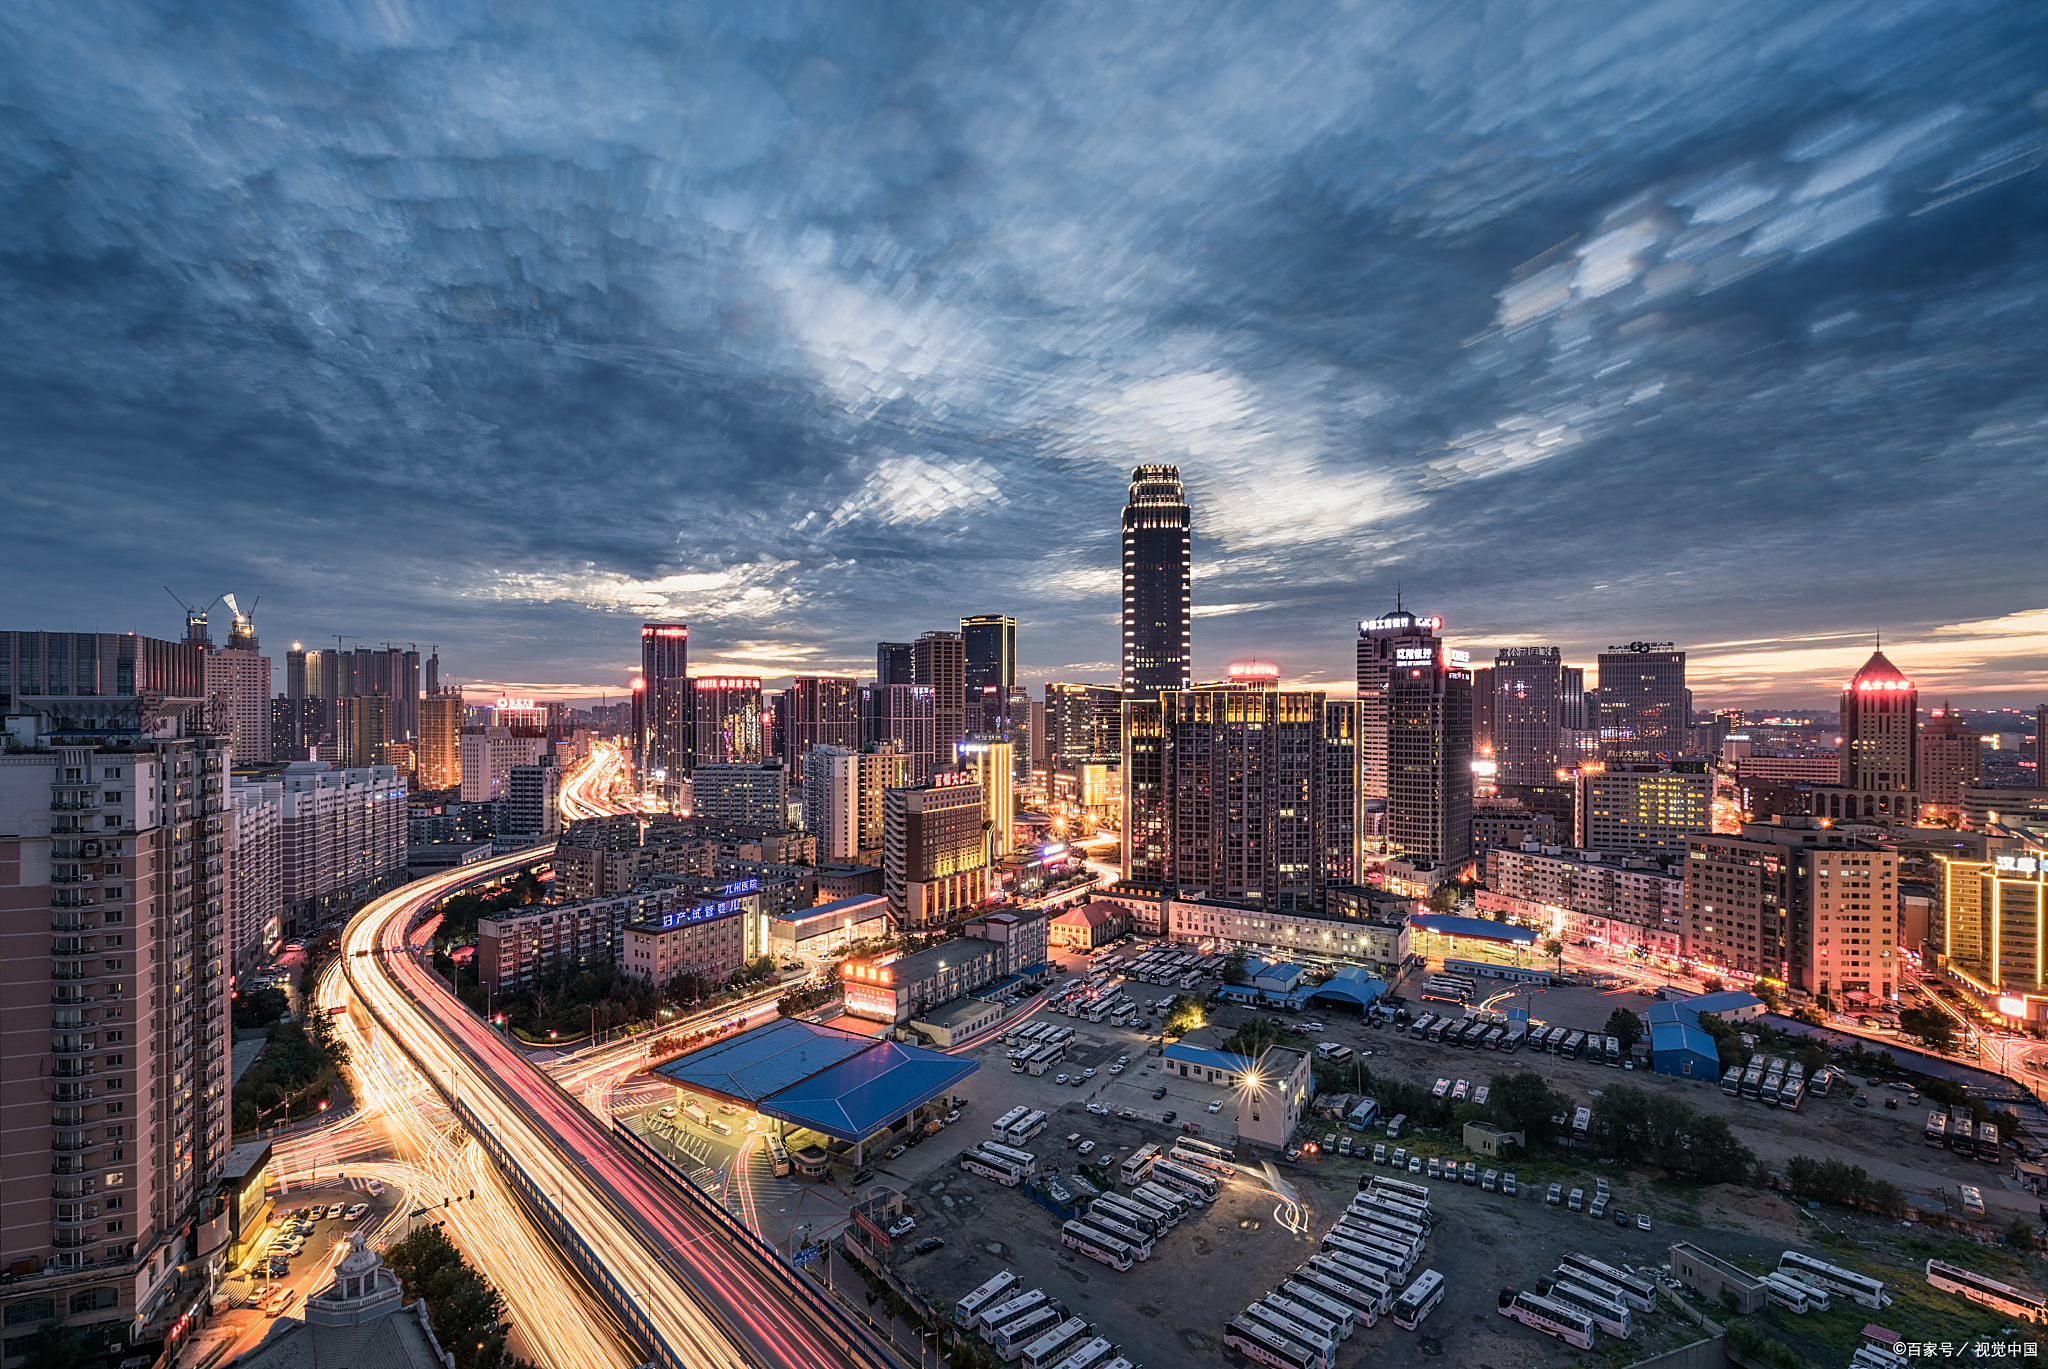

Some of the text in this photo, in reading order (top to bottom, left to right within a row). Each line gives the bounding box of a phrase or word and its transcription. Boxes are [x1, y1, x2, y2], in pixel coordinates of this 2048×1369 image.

[1361, 617, 1409, 631] 中国工商银行
[719, 679, 760, 689] 华府新天地
[724, 878, 759, 896] 九州医院
